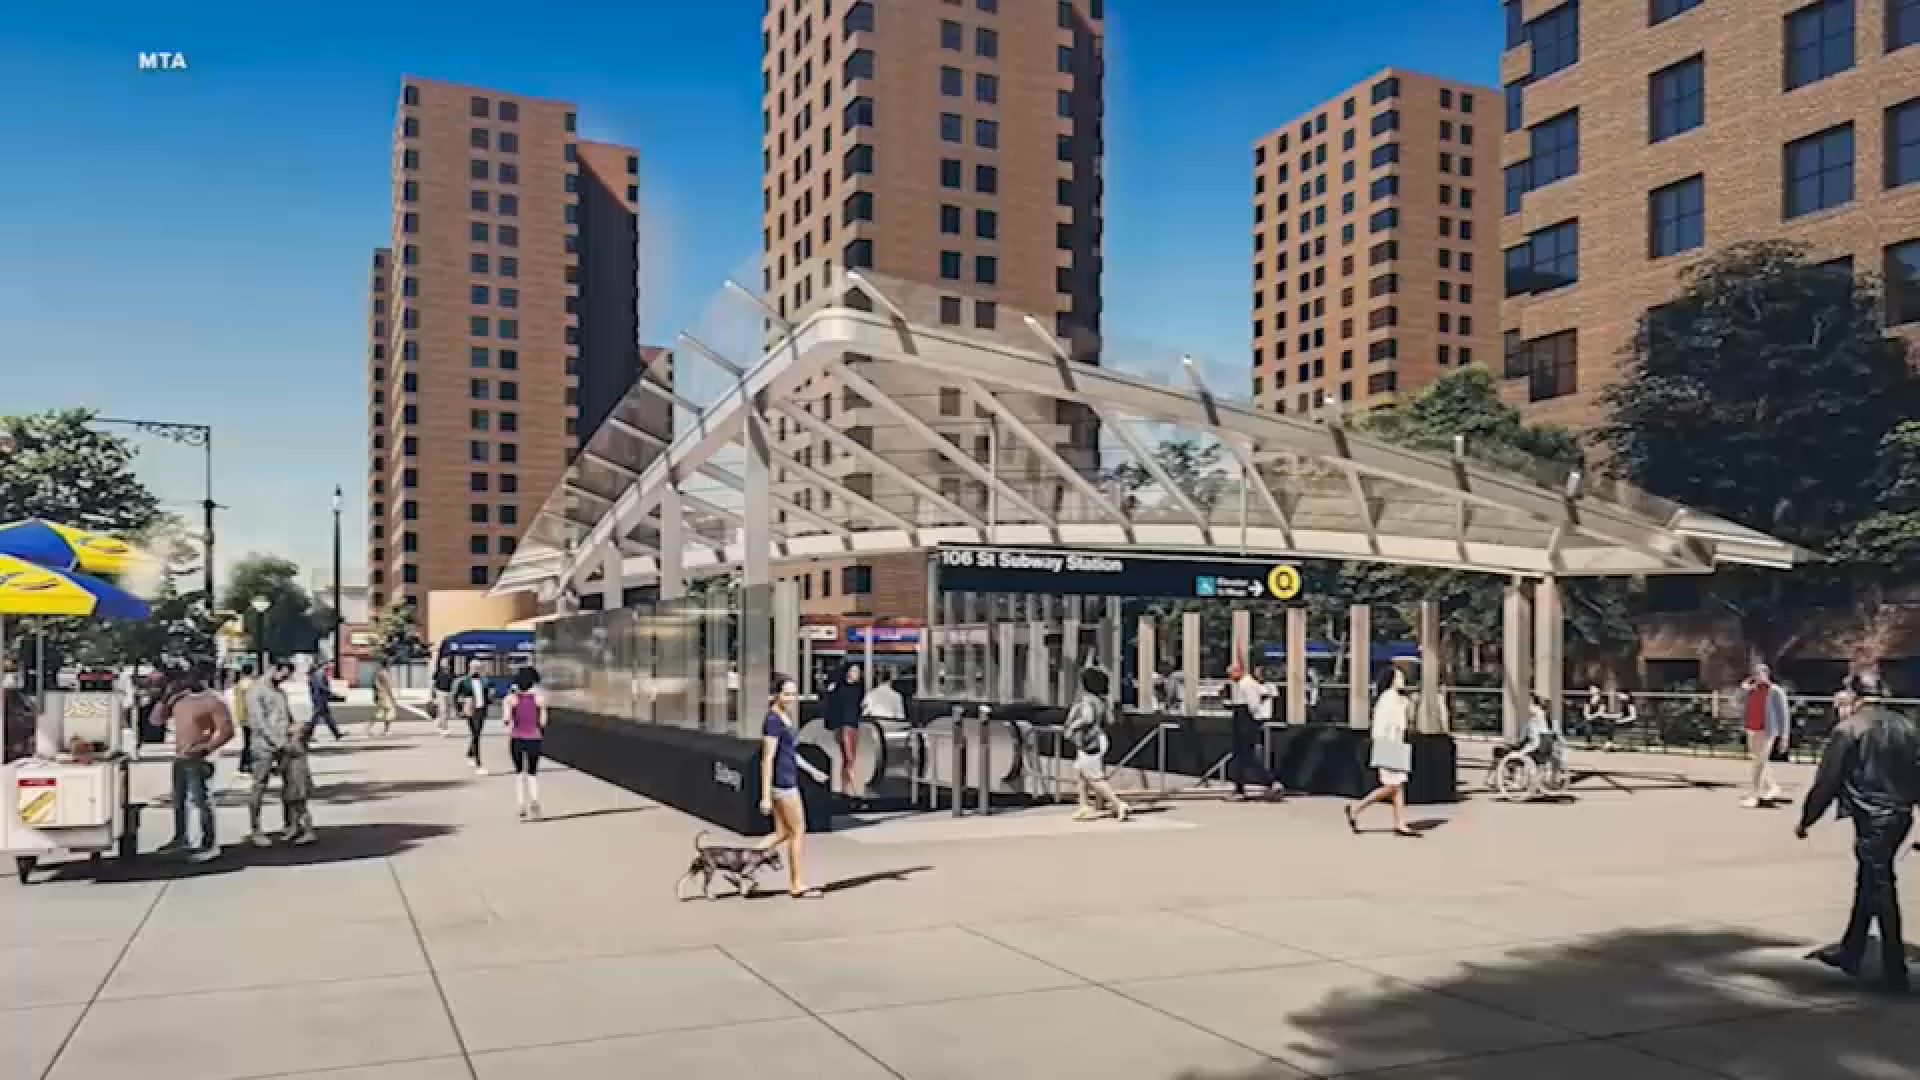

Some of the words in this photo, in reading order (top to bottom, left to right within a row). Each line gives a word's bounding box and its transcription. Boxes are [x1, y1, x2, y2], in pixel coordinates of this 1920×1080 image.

[943, 551, 974, 567] 106
[976, 552, 995, 567] St
[998, 553, 1062, 573] Subway
[1066, 554, 1123, 571] Station
[1275, 571, 1293, 591] Q
